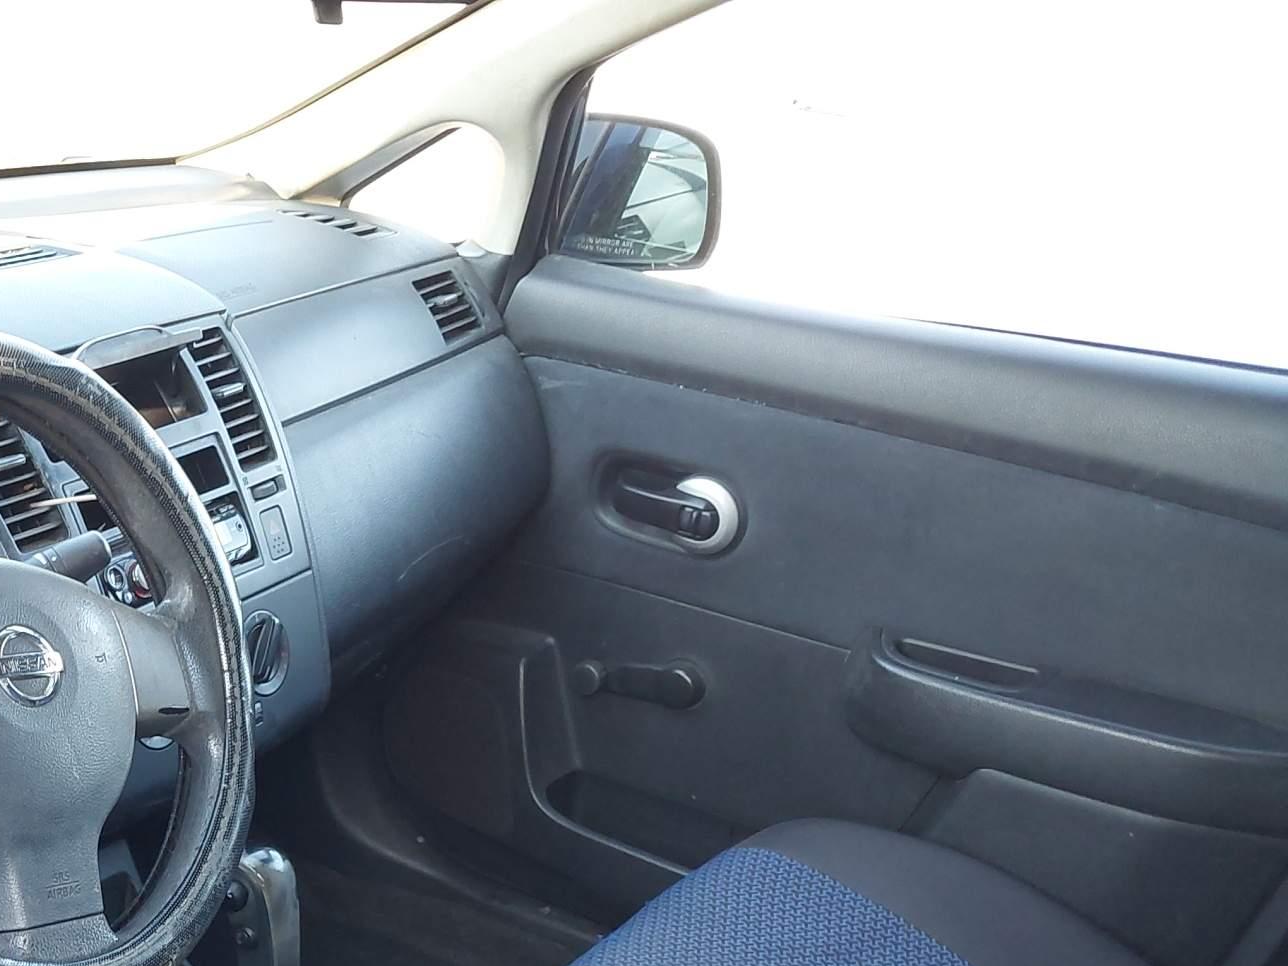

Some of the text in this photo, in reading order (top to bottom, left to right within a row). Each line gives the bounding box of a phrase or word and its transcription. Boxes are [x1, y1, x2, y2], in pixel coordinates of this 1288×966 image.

[595, 237, 620, 247] MIRROR
[0, 655, 58, 673] NISSAN
[52, 870, 71, 883] SRS
[47, 883, 82, 899] AIRBAG
